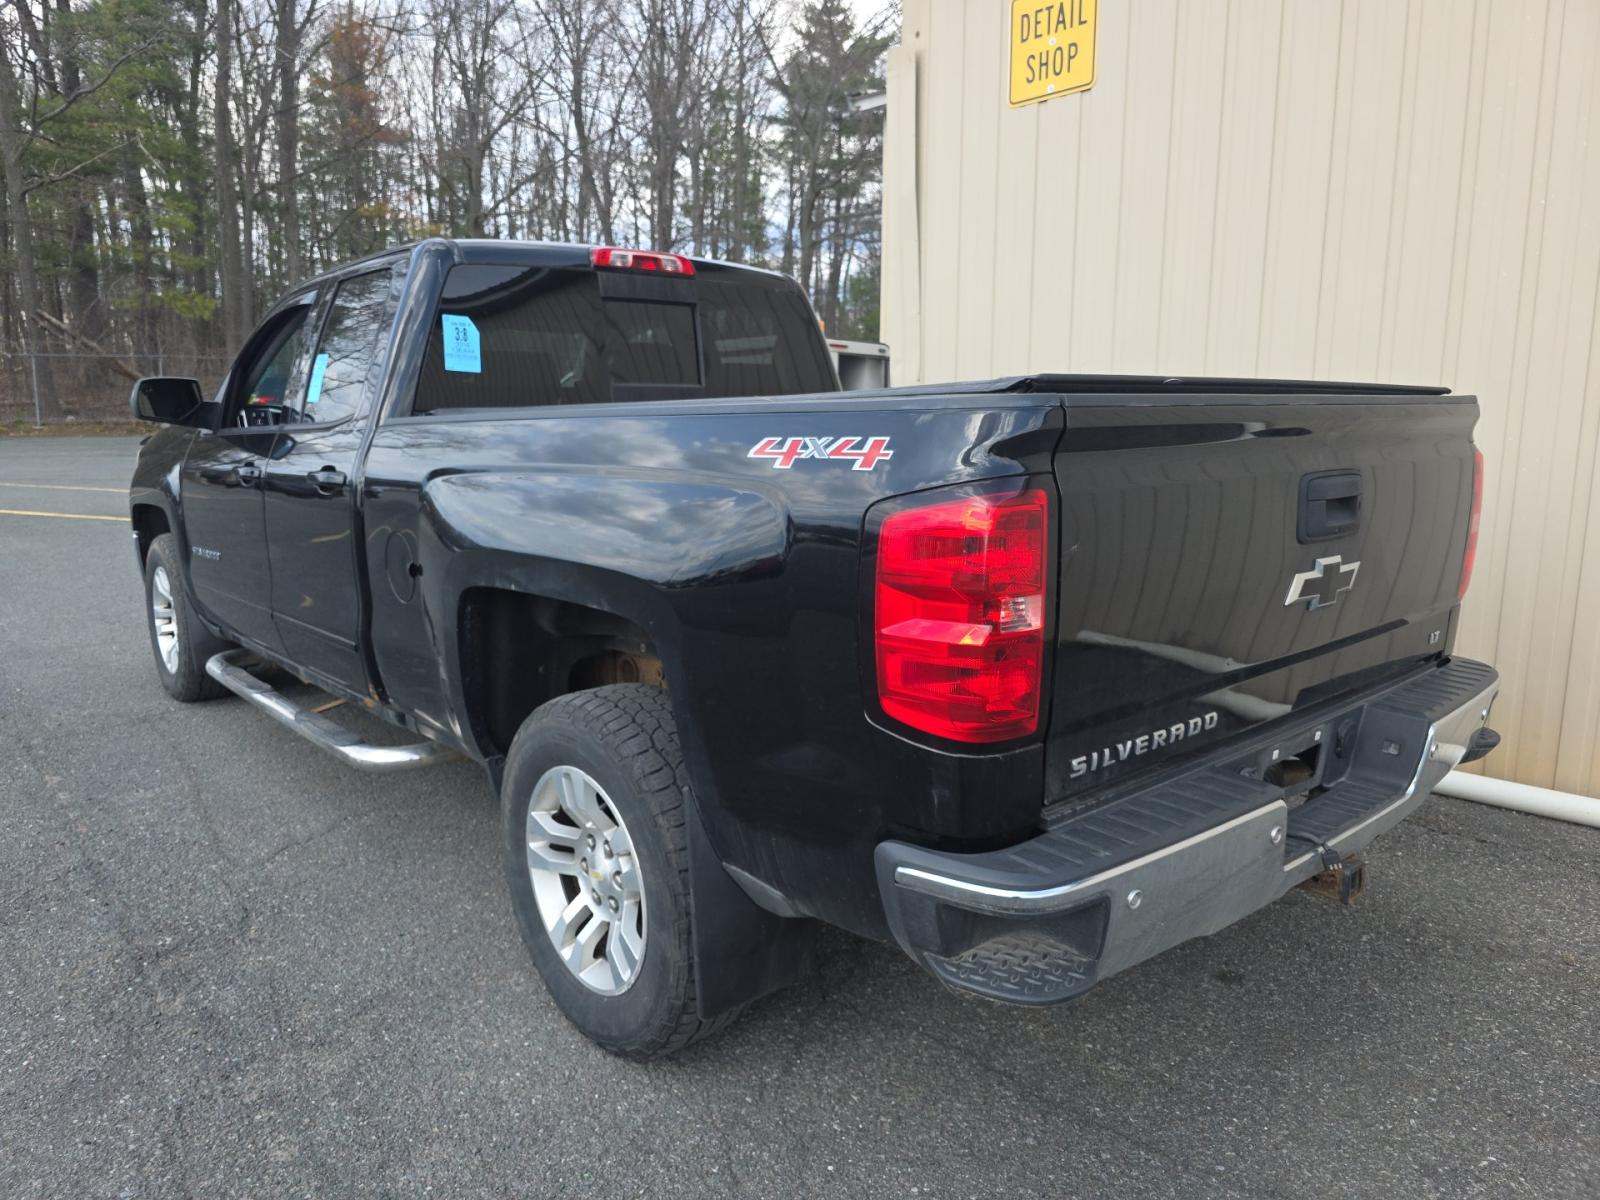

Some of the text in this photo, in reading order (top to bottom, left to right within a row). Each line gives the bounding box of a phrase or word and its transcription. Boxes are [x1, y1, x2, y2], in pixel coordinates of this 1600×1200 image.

[1020, 0, 1088, 43] DETAIL
[1026, 42, 1078, 84] SHOP
[1070, 711, 1218, 778] SILVERADO
